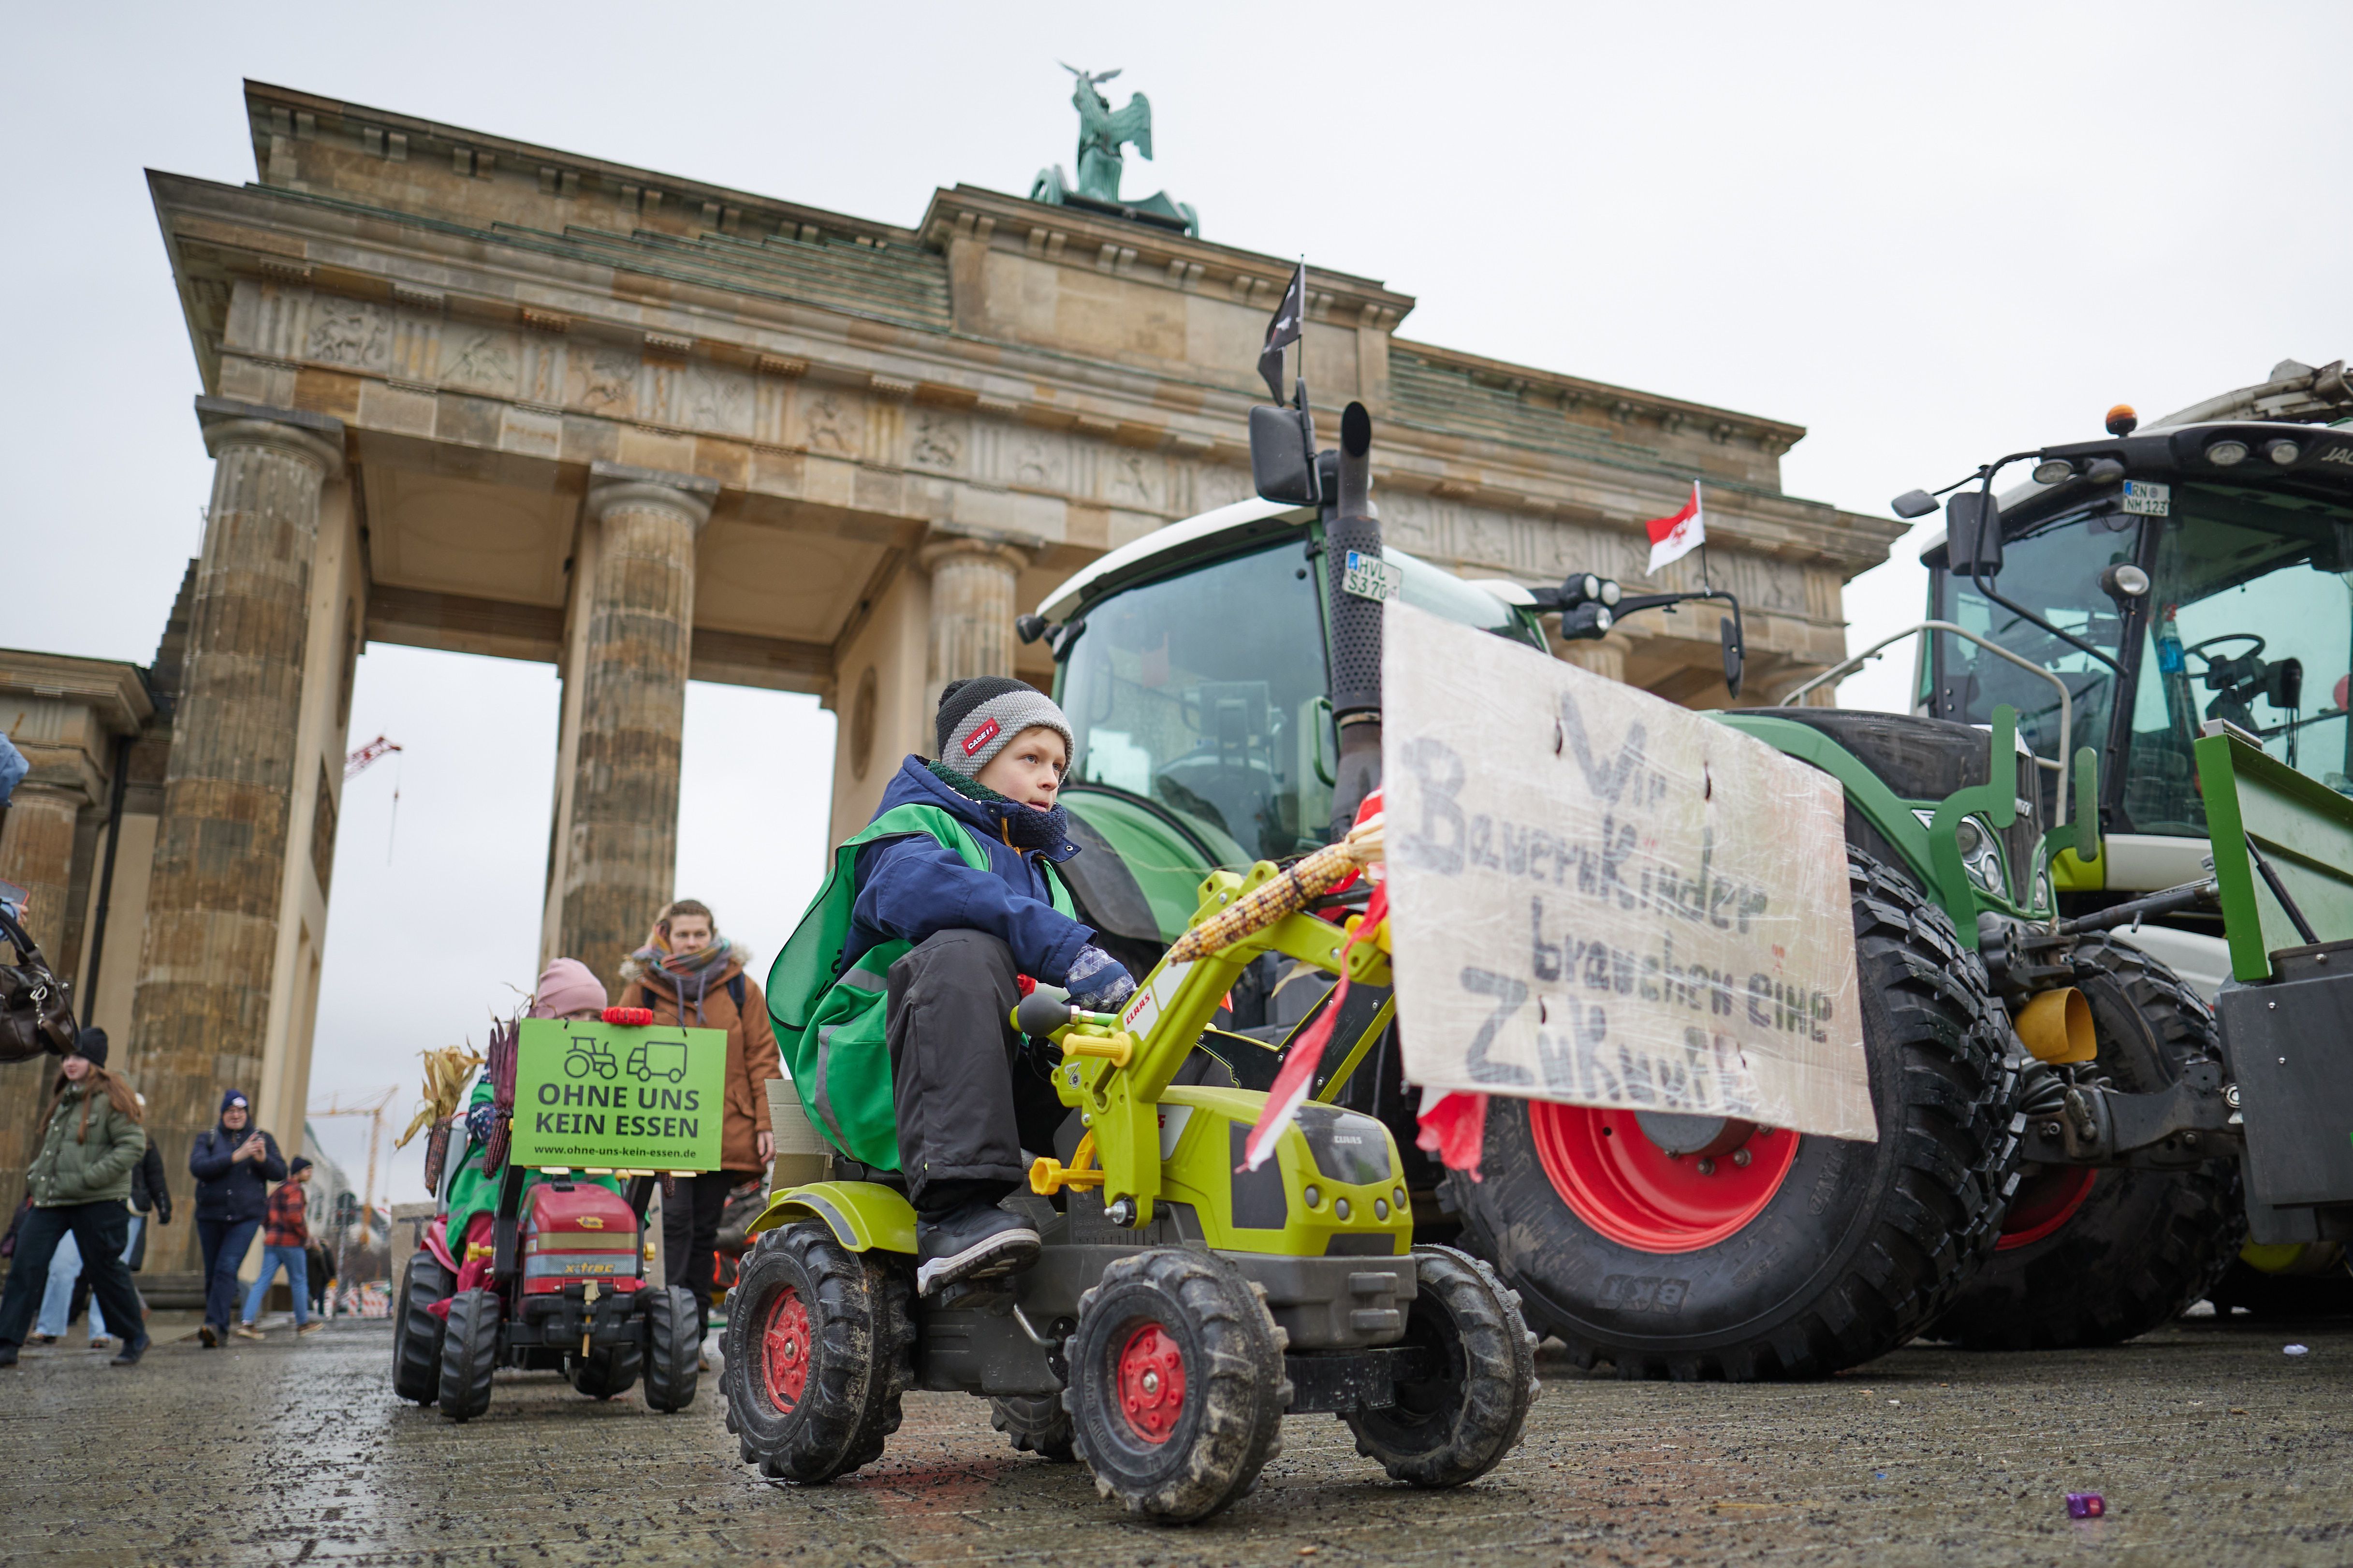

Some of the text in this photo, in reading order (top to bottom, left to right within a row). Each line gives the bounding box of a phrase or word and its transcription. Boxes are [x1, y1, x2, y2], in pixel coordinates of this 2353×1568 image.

[2133, 485, 2147, 497] RN
[2146, 500, 2166, 513] 123
[1359, 559, 1386, 581] HVL
[1562, 690, 1667, 813] Wir
[1532, 895, 1833, 1043] brauchen eine
[1126, 993, 1150, 1025] CLAAS
[538, 1083, 700, 1111] OHNE UNS
[535, 1113, 699, 1138] KEIN ESSEN
[1333, 1135, 1362, 1145] CLAAS
[534, 1145, 697, 1159] www.ohne-uns-kein-essen.de
